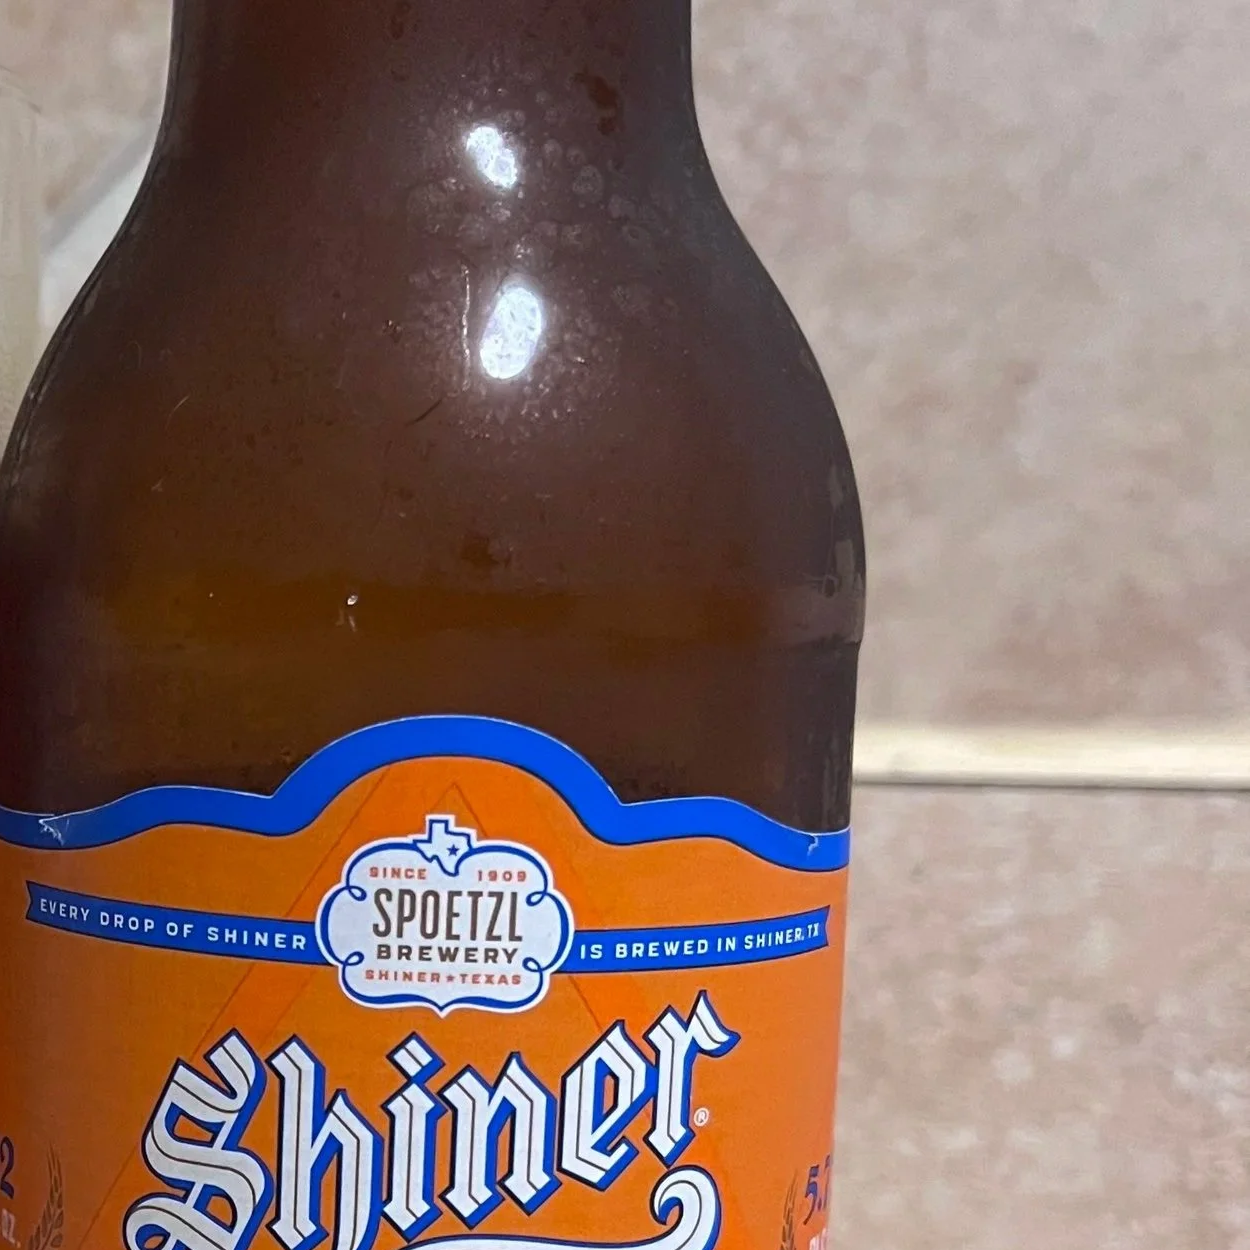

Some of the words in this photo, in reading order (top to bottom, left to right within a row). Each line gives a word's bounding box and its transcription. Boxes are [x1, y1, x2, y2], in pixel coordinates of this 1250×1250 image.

[369, 866, 427, 880] SINCE
[478, 870, 527, 882] 1909
[40, 898, 90, 922] EVERY
[100, 912, 155, 933] DROP
[166, 922, 194, 938] OF
[207, 927, 306, 951] SHINER
[372, 888, 523, 943] SPOETZL
[377, 944, 518, 964] BREWERY
[580, 944, 603, 959] IS
[615, 939, 709, 959] BREWED
[717, 936, 736, 952] IN
[807, 922, 820, 939] TX
[365, 969, 441, 983] SHINER
[460, 972, 522, 985] TEXAS
